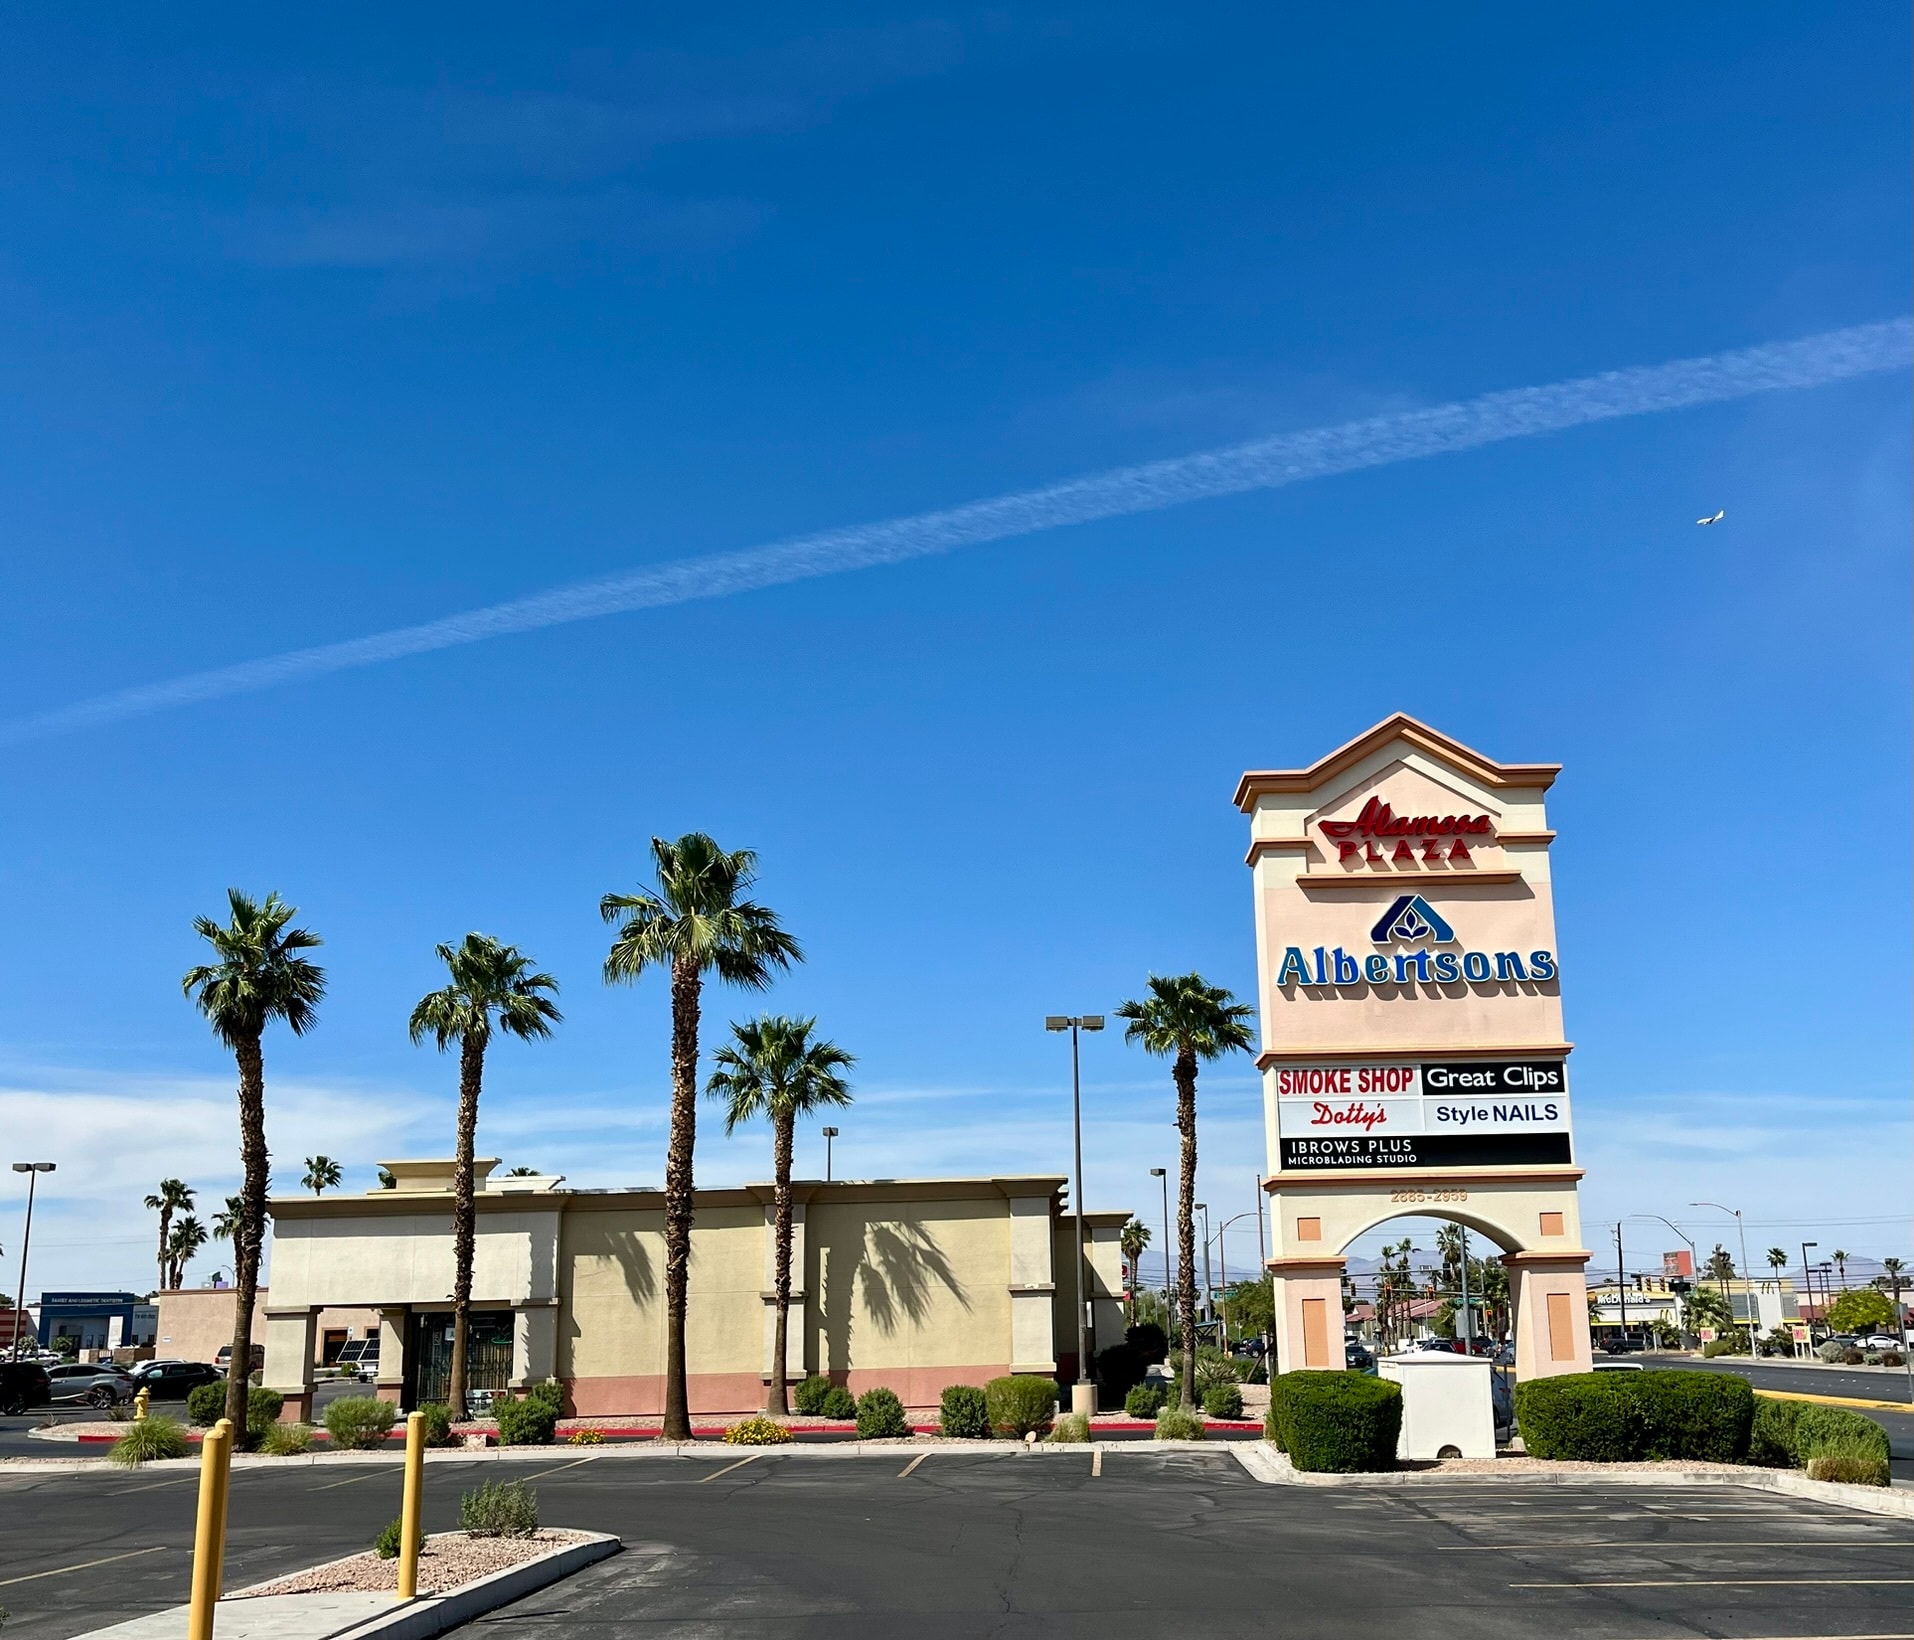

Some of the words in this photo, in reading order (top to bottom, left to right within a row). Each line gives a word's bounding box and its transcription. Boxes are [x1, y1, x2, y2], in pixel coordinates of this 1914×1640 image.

[1318, 795, 1491, 837] Alamosa
[1338, 838, 1471, 862] PLAZA
[1276, 946, 1556, 986] Albertsons
[1279, 1069, 1351, 1094] SMOKE
[1358, 1067, 1414, 1093] SHOP
[1426, 1068, 1496, 1087] Great
[1503, 1066, 1559, 1090] Clips
[1310, 1102, 1387, 1131] Dotty's
[1436, 1106, 1489, 1125] Style
[1493, 1104, 1558, 1122] NAILS
[1292, 1141, 1360, 1154] IBROWS
[1368, 1139, 1412, 1153] PLUS
[1288, 1156, 1372, 1165] MICROBLADING
[1377, 1154, 1417, 1163] STUDIO
